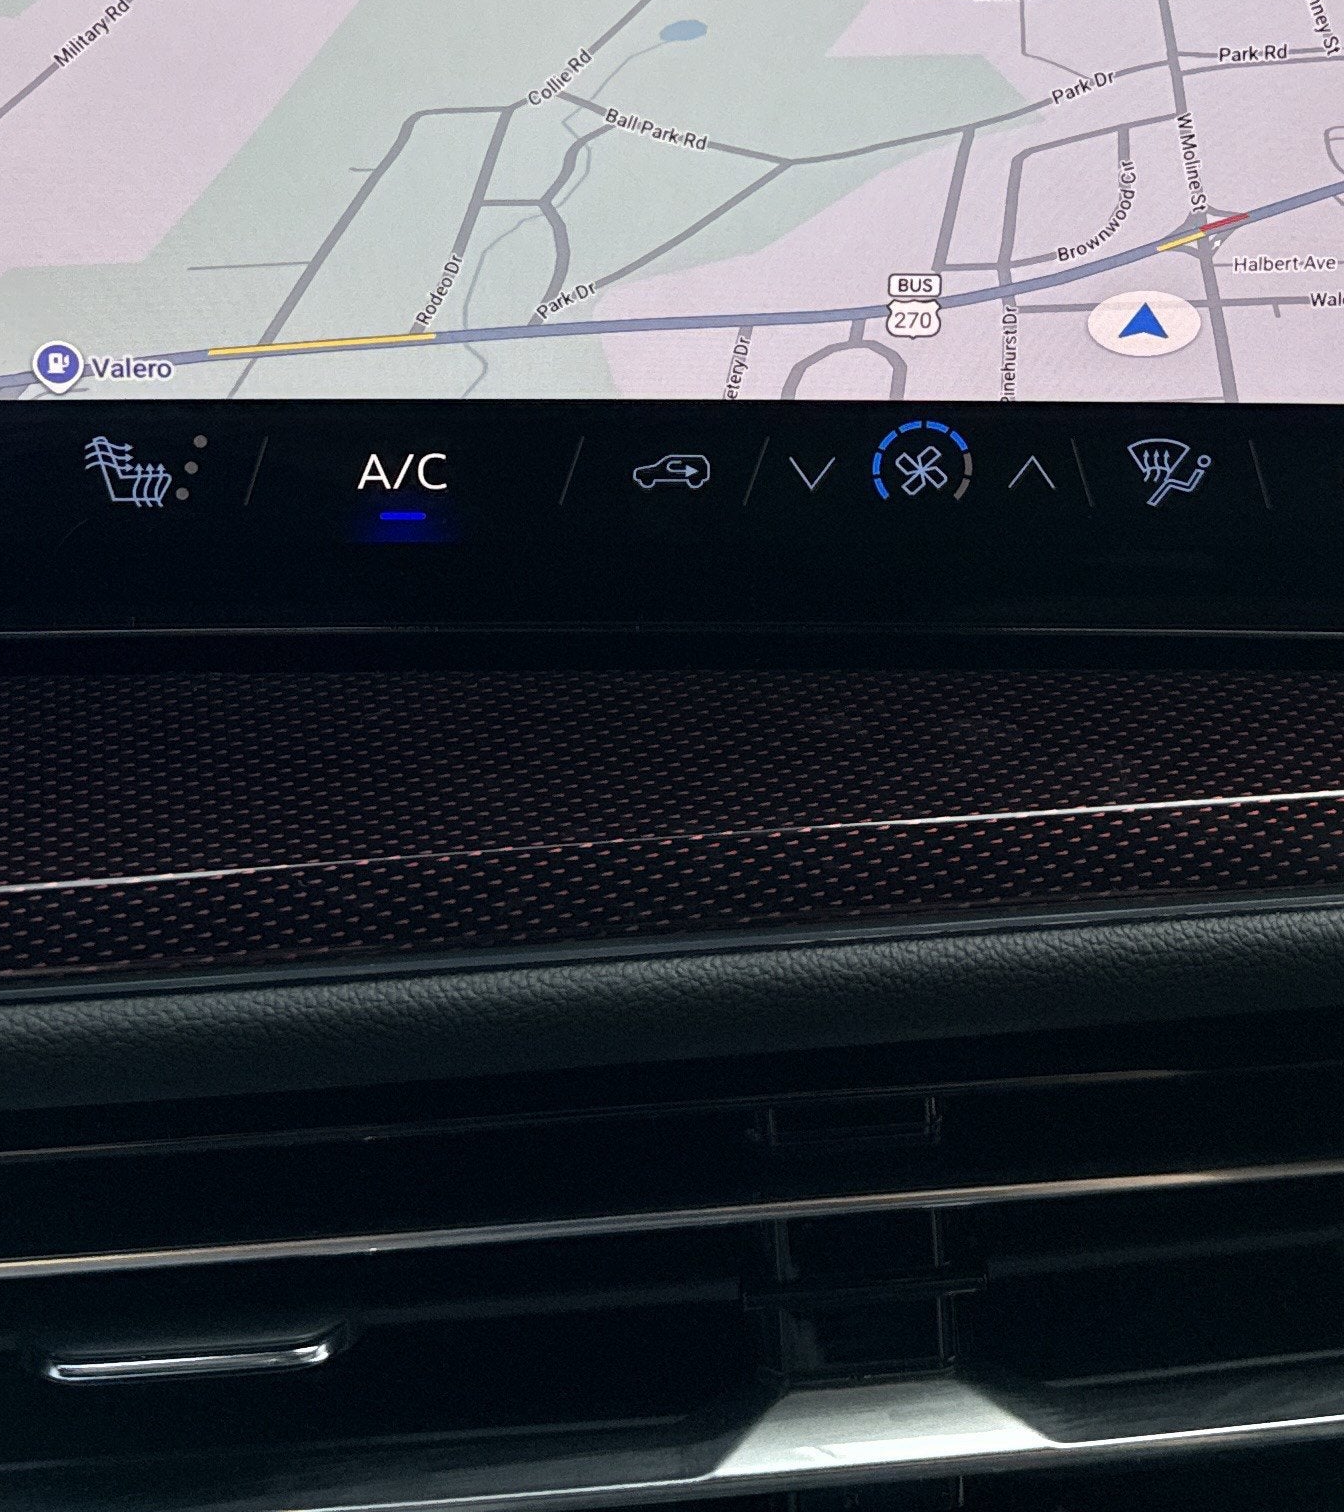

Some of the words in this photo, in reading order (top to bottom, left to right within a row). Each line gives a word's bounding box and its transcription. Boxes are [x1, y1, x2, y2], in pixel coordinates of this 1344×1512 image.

[53, 17, 110, 68] Military
[1219, 46, 1258, 61] Park
[1264, 44, 1287, 60] Rd
[1323, 35, 1340, 56] St
[528, 67, 571, 106] Collie
[566, 48, 593, 75] Rd
[1051, 79, 1091, 106] Park
[1094, 71, 1117, 89] Dr
[605, 108, 639, 133] Ball
[640, 121, 679, 145] Park
[682, 132, 708, 150] Rd
[1177, 112, 1193, 130] W
[1181, 134, 1202, 192] Moline
[1058, 190, 1136, 262] Brownwood
[1120, 160, 1137, 185] Cir
[1190, 193, 1207, 212] St
[1234, 256, 1296, 272] Halbert
[1304, 256, 1336, 271] Ave
[416, 274, 455, 326] Rodeo
[444, 255, 462, 276] Dr
[898, 278, 933, 292] BUS
[536, 292, 575, 320] Park
[575, 281, 597, 302] Dr
[894, 312, 932, 329] 270
[1002, 306, 1017, 324] Dr
[733, 336, 750, 356] Dr
[92, 358, 172, 379] Valero
[726, 359, 748, 399] etery
[357, 452, 448, 491] A/C
